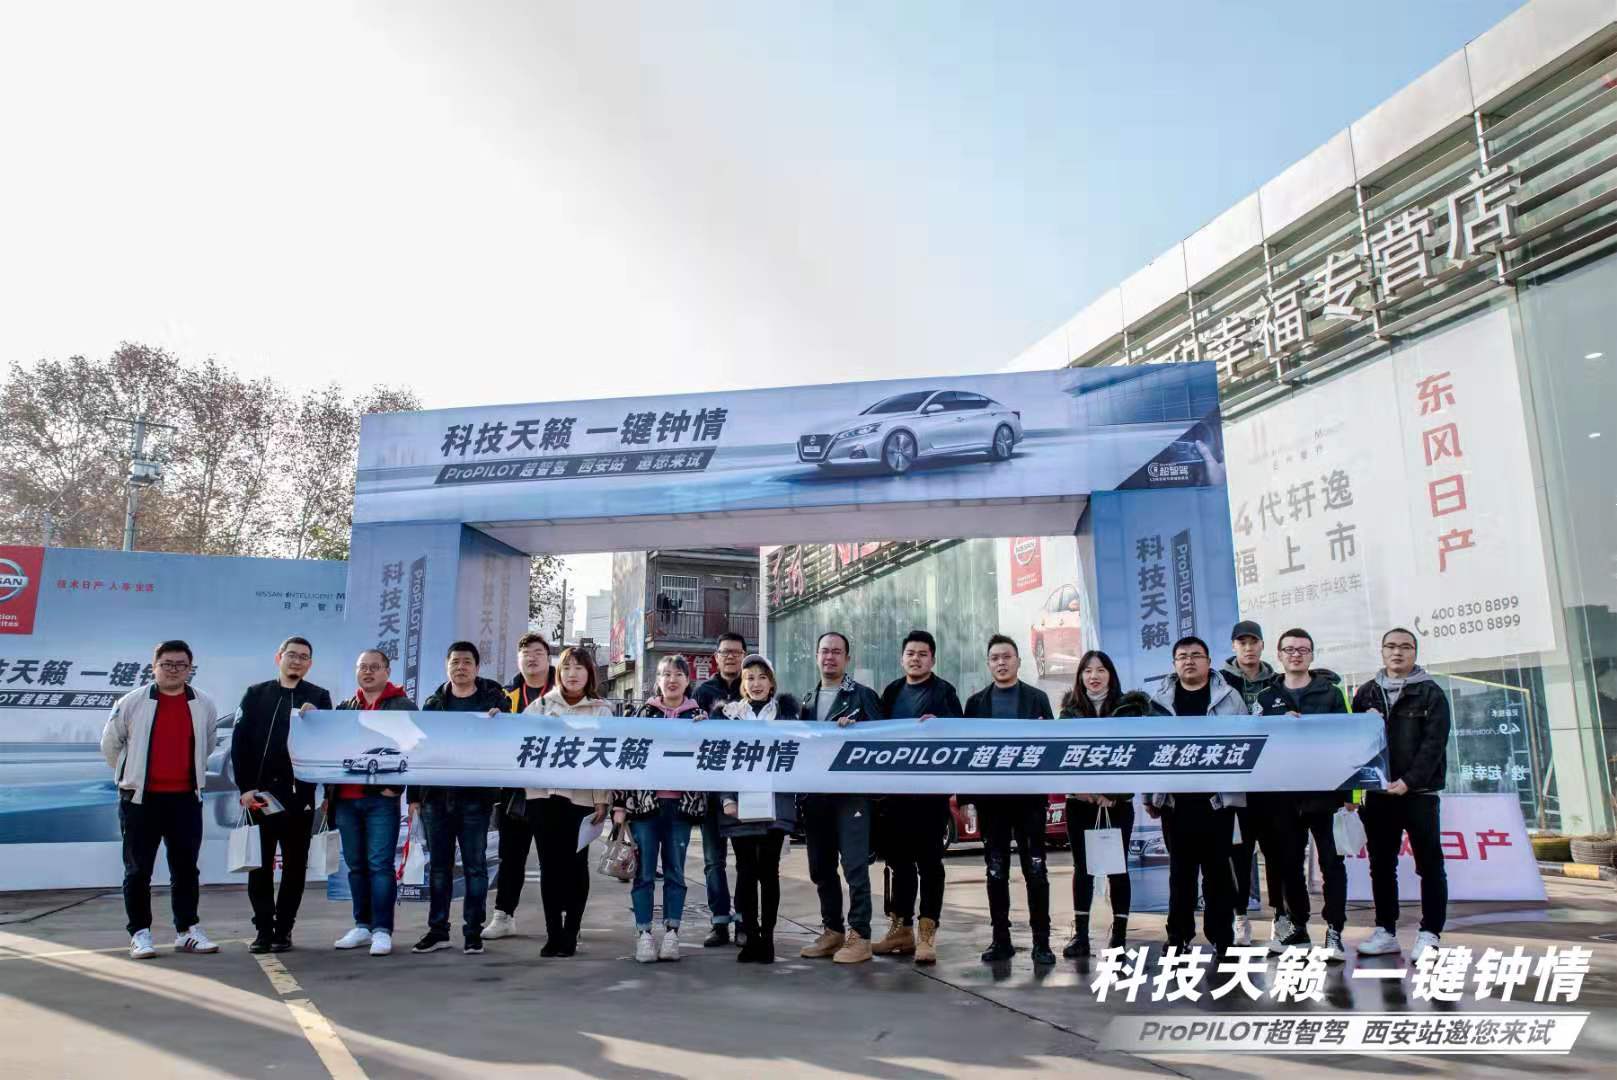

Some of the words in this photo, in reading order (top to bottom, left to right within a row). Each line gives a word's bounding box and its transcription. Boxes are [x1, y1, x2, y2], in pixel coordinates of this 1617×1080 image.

[1147, 164, 1520, 377] 幸福专营店
[440, 416, 577, 457] 科技天籁
[586, 408, 728, 444] 一键钟情
[1416, 371, 1476, 573] 东风日产
[1136, 534, 1171, 651] 科技天籁
[1431, 607, 1455, 620] 400
[1457, 602, 1482, 617] 830
[1485, 595, 1519, 612] 8899
[1433, 624, 1457, 638] 800
[1459, 619, 1483, 634] 830
[1487, 614, 1521, 630] 8899
[516, 736, 653, 769] 科技天籁
[663, 739, 800, 772] 一键钟情
[1059, 744, 1136, 768] 西安站
[1149, 743, 1250, 767] 邀您来试
